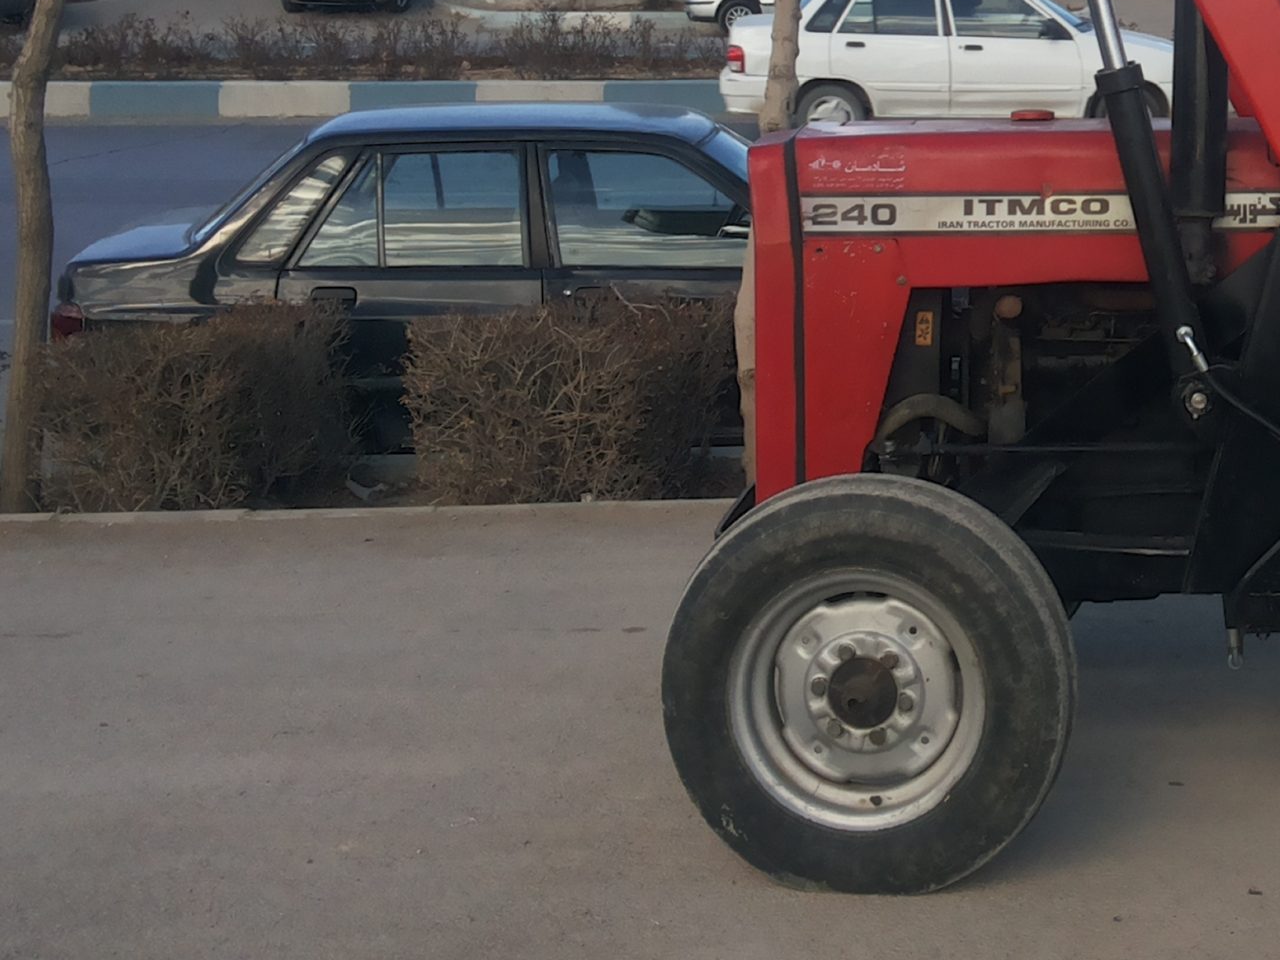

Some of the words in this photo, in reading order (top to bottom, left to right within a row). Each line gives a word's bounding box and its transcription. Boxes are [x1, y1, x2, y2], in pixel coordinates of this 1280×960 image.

[811, 203, 897, 226] 240
[963, 197, 1110, 216] ITMCO
[937, 220, 964, 229] IRAN
[967, 220, 1015, 229] TRACTOR
[1018, 219, 1110, 229] MANUFACTURING
